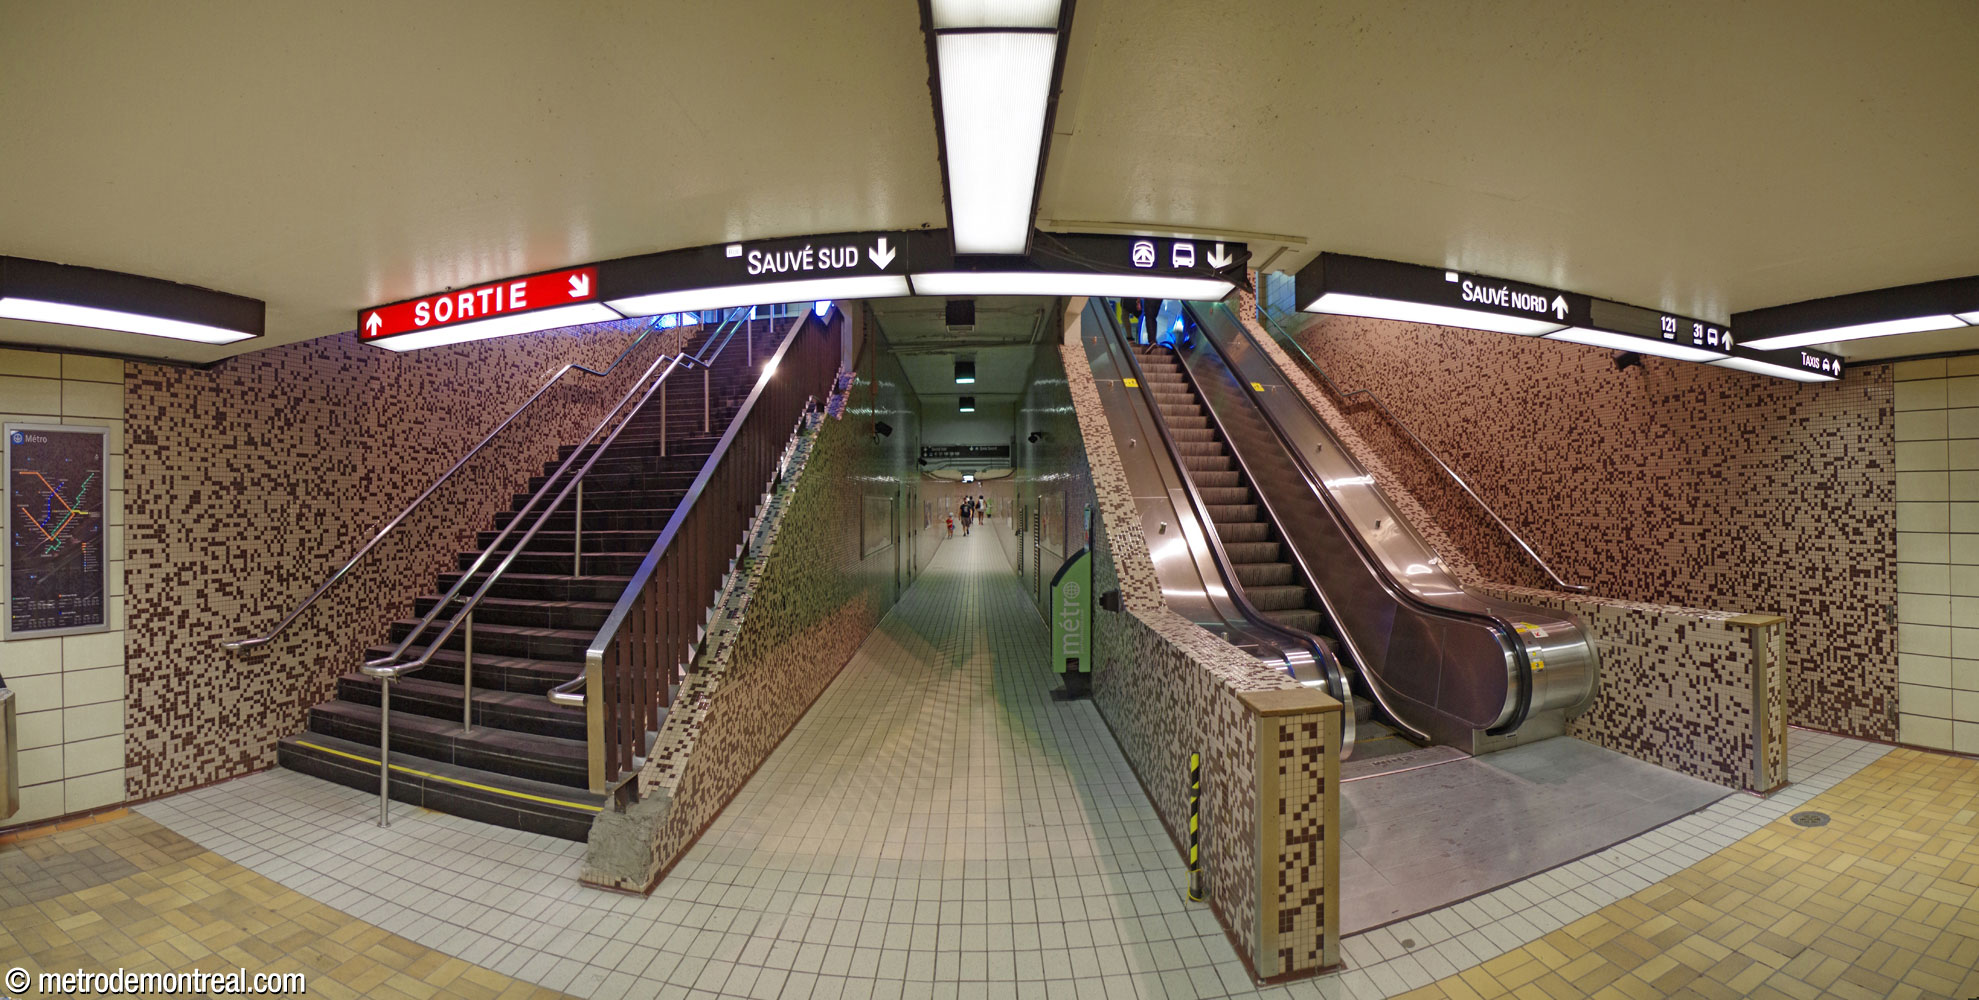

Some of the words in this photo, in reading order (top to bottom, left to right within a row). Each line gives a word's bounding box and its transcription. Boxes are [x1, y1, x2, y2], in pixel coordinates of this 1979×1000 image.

[748, 245, 814, 274] SAUVÉ
[818, 247, 859, 269] SUD
[414, 281, 527, 326] SORTIE
[1462, 280, 1509, 307] SAUVÉ
[1511, 293, 1547, 313] NORD
[1660, 316, 1676, 333] 121
[1693, 323, 1703, 338] 31
[1801, 351, 1820, 369] TAXIS
[25, 434, 48, 444] Métro
